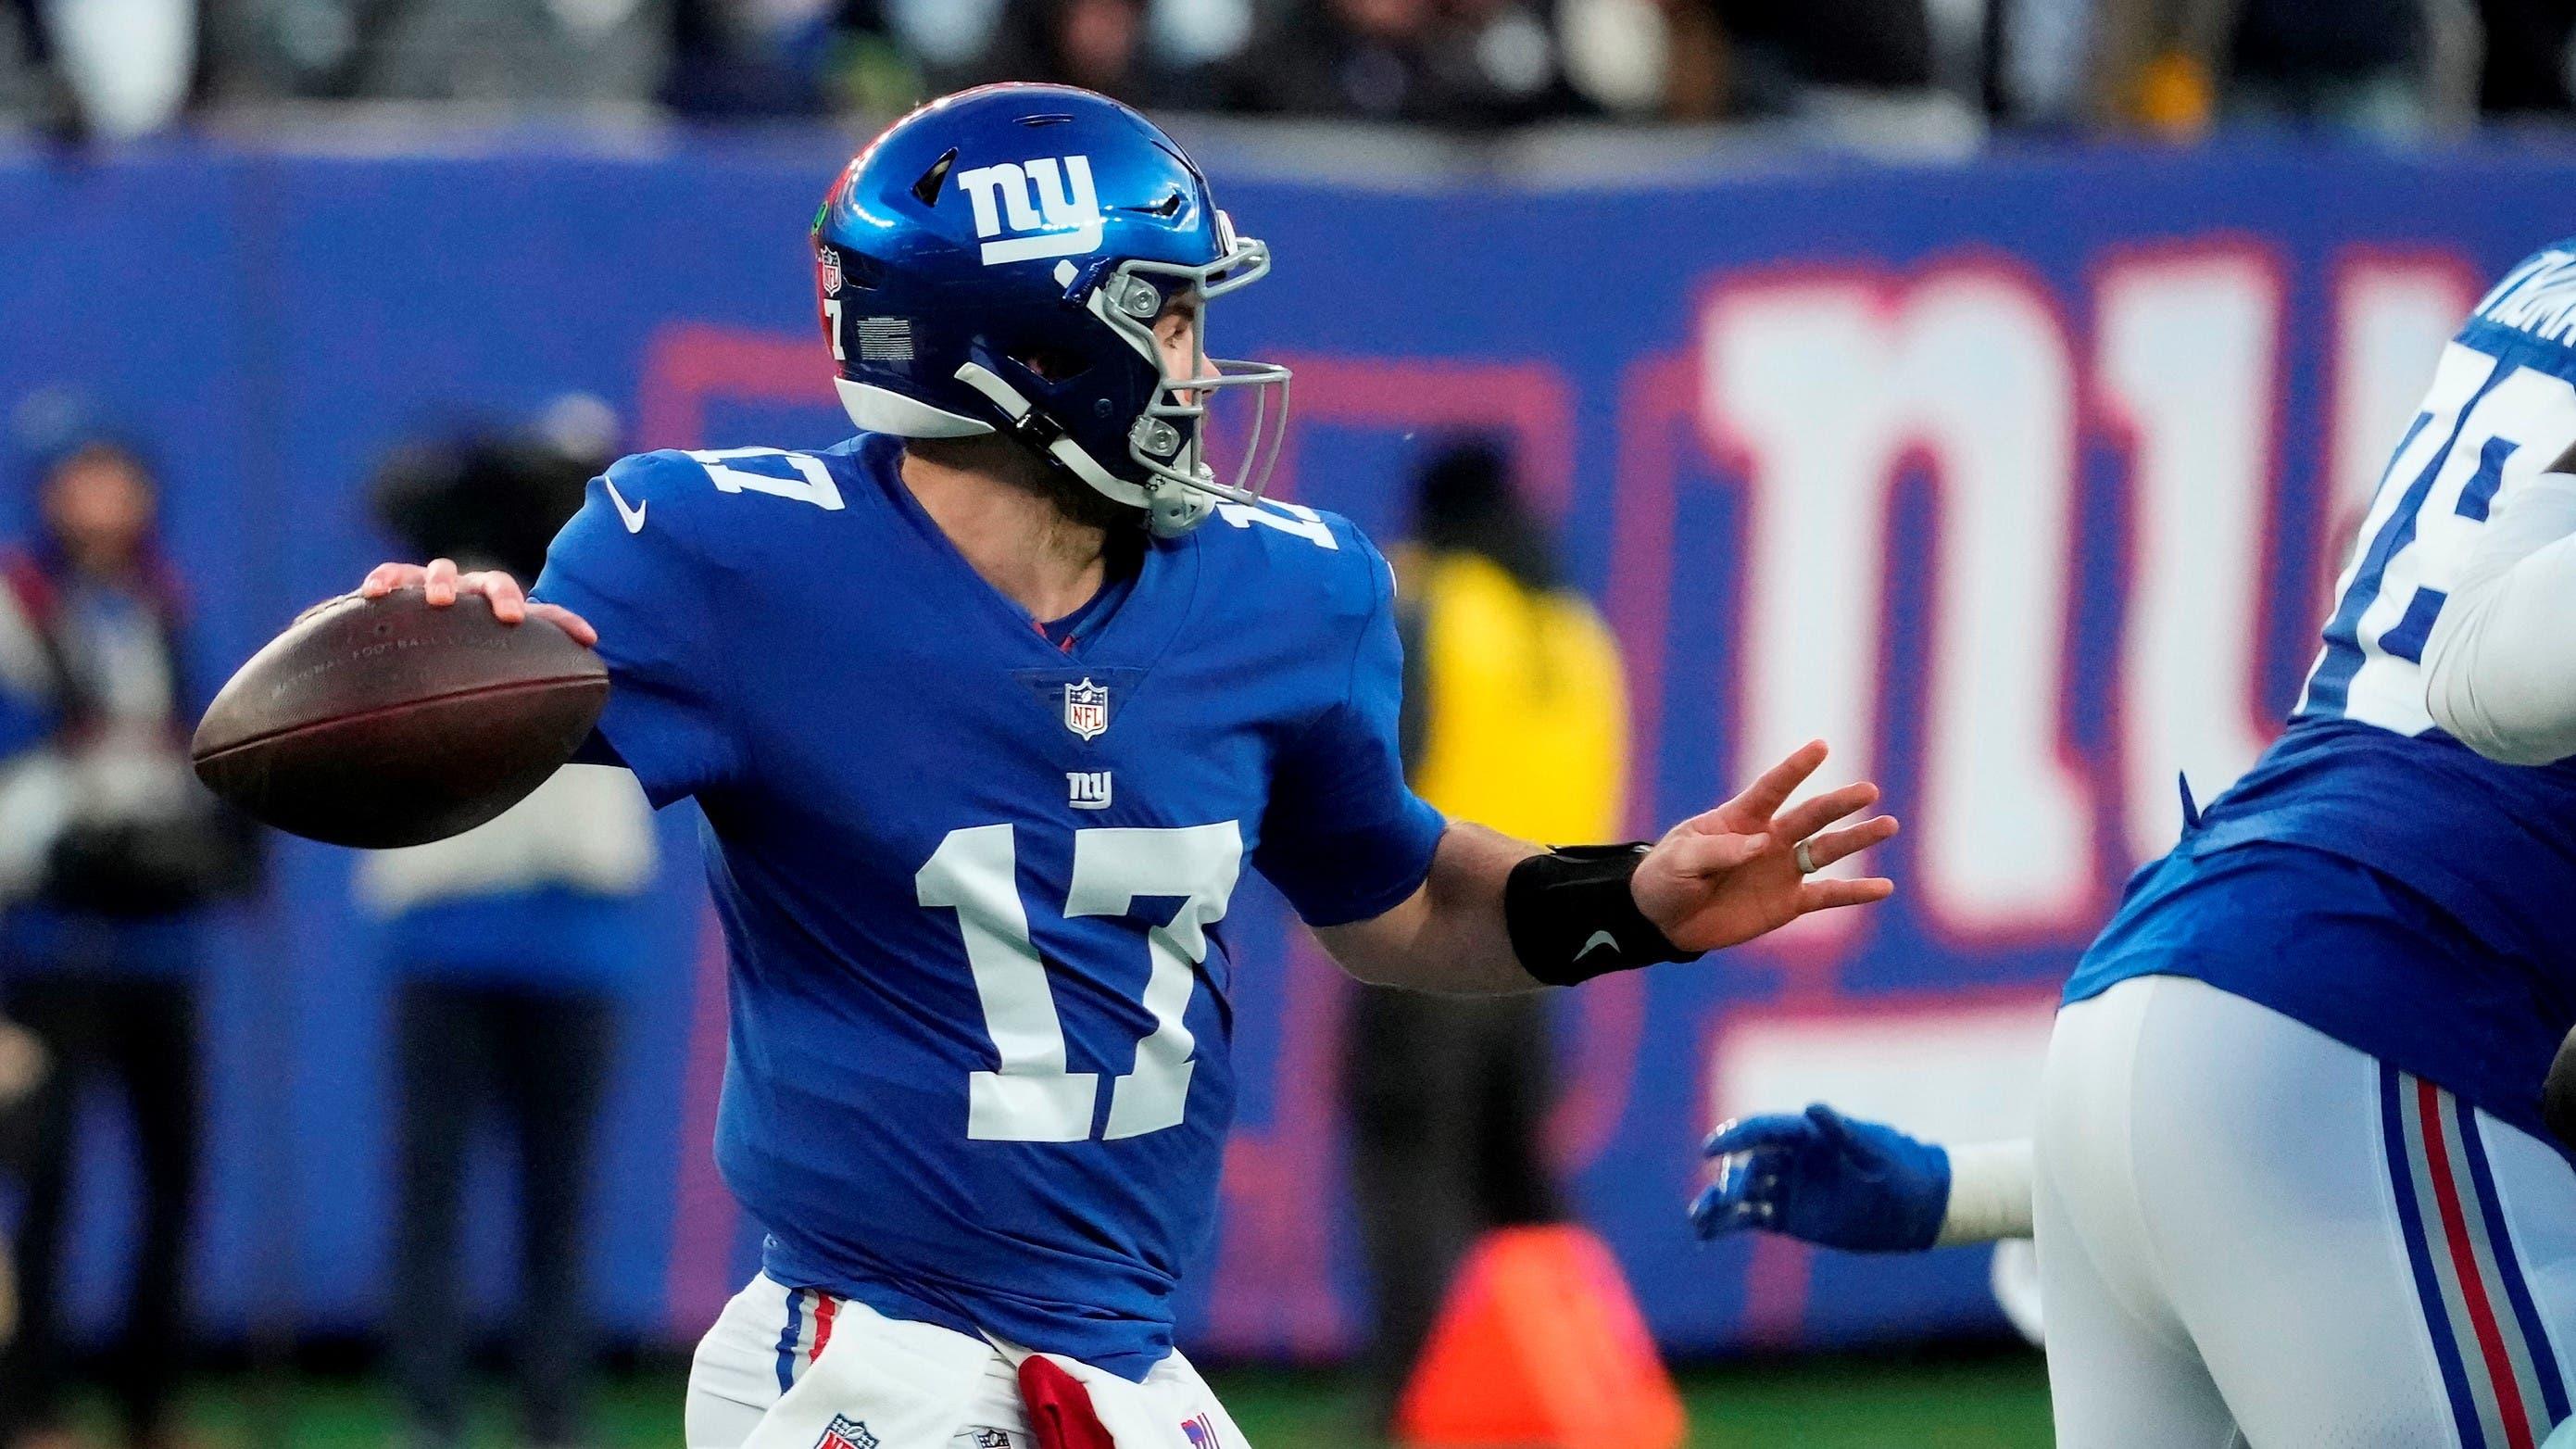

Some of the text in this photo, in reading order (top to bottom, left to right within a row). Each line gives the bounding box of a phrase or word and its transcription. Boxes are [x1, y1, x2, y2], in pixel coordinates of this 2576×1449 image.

[959, 155, 1103, 266] ny
[1072, 705, 1102, 730] NFL
[1066, 771, 1112, 810] ny
[914, 819, 1244, 1143] 17
